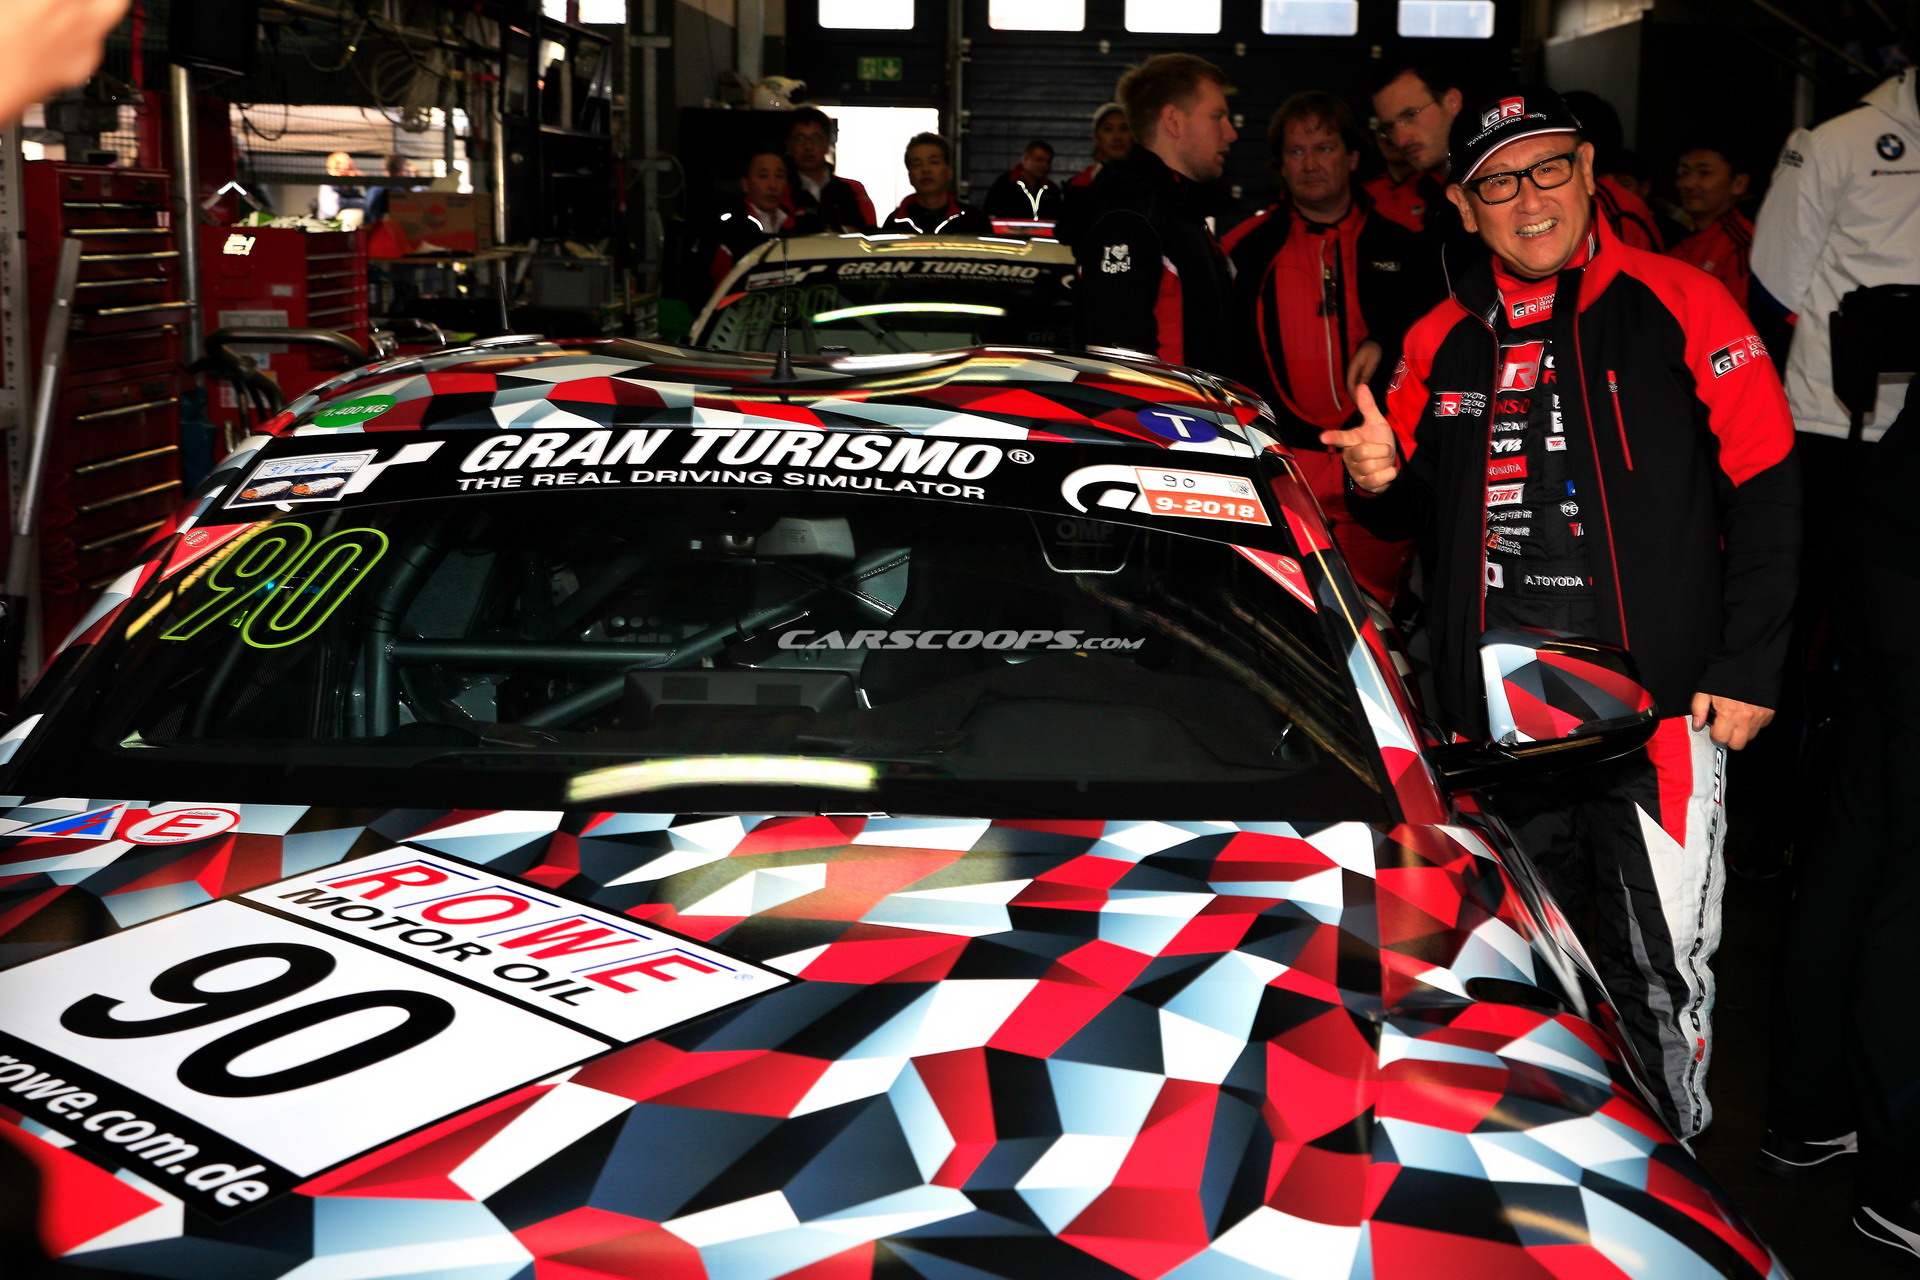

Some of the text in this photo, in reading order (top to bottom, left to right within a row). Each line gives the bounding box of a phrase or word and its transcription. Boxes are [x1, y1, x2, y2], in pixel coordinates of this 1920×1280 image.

[1483, 103, 1523, 128] GR
[837, 261, 1039, 280] GRAN TURISMO
[1101, 256, 1131, 274] Cars!
[1514, 304, 1538, 319] GR
[1500, 361, 1537, 388] R
[1714, 350, 1748, 376] GR
[363, 404, 389, 414] KG
[1151, 411, 1197, 439] T
[459, 429, 1003, 480] GRAN TURISMO
[1491, 438, 1522, 453] YB
[456, 470, 985, 500] THE REAL DRIVING SIMULATOR
[1163, 474, 1196, 488] 90
[1154, 496, 1256, 519] 9-2018
[159, 522, 389, 649] 90
[1524, 575, 1584, 587] A.TOYODA
[143, 814, 221, 837] E
[327, 865, 720, 994] ROWE
[278, 888, 596, 1007] MOTOR OIL
[60, 943, 456, 1098] 90
